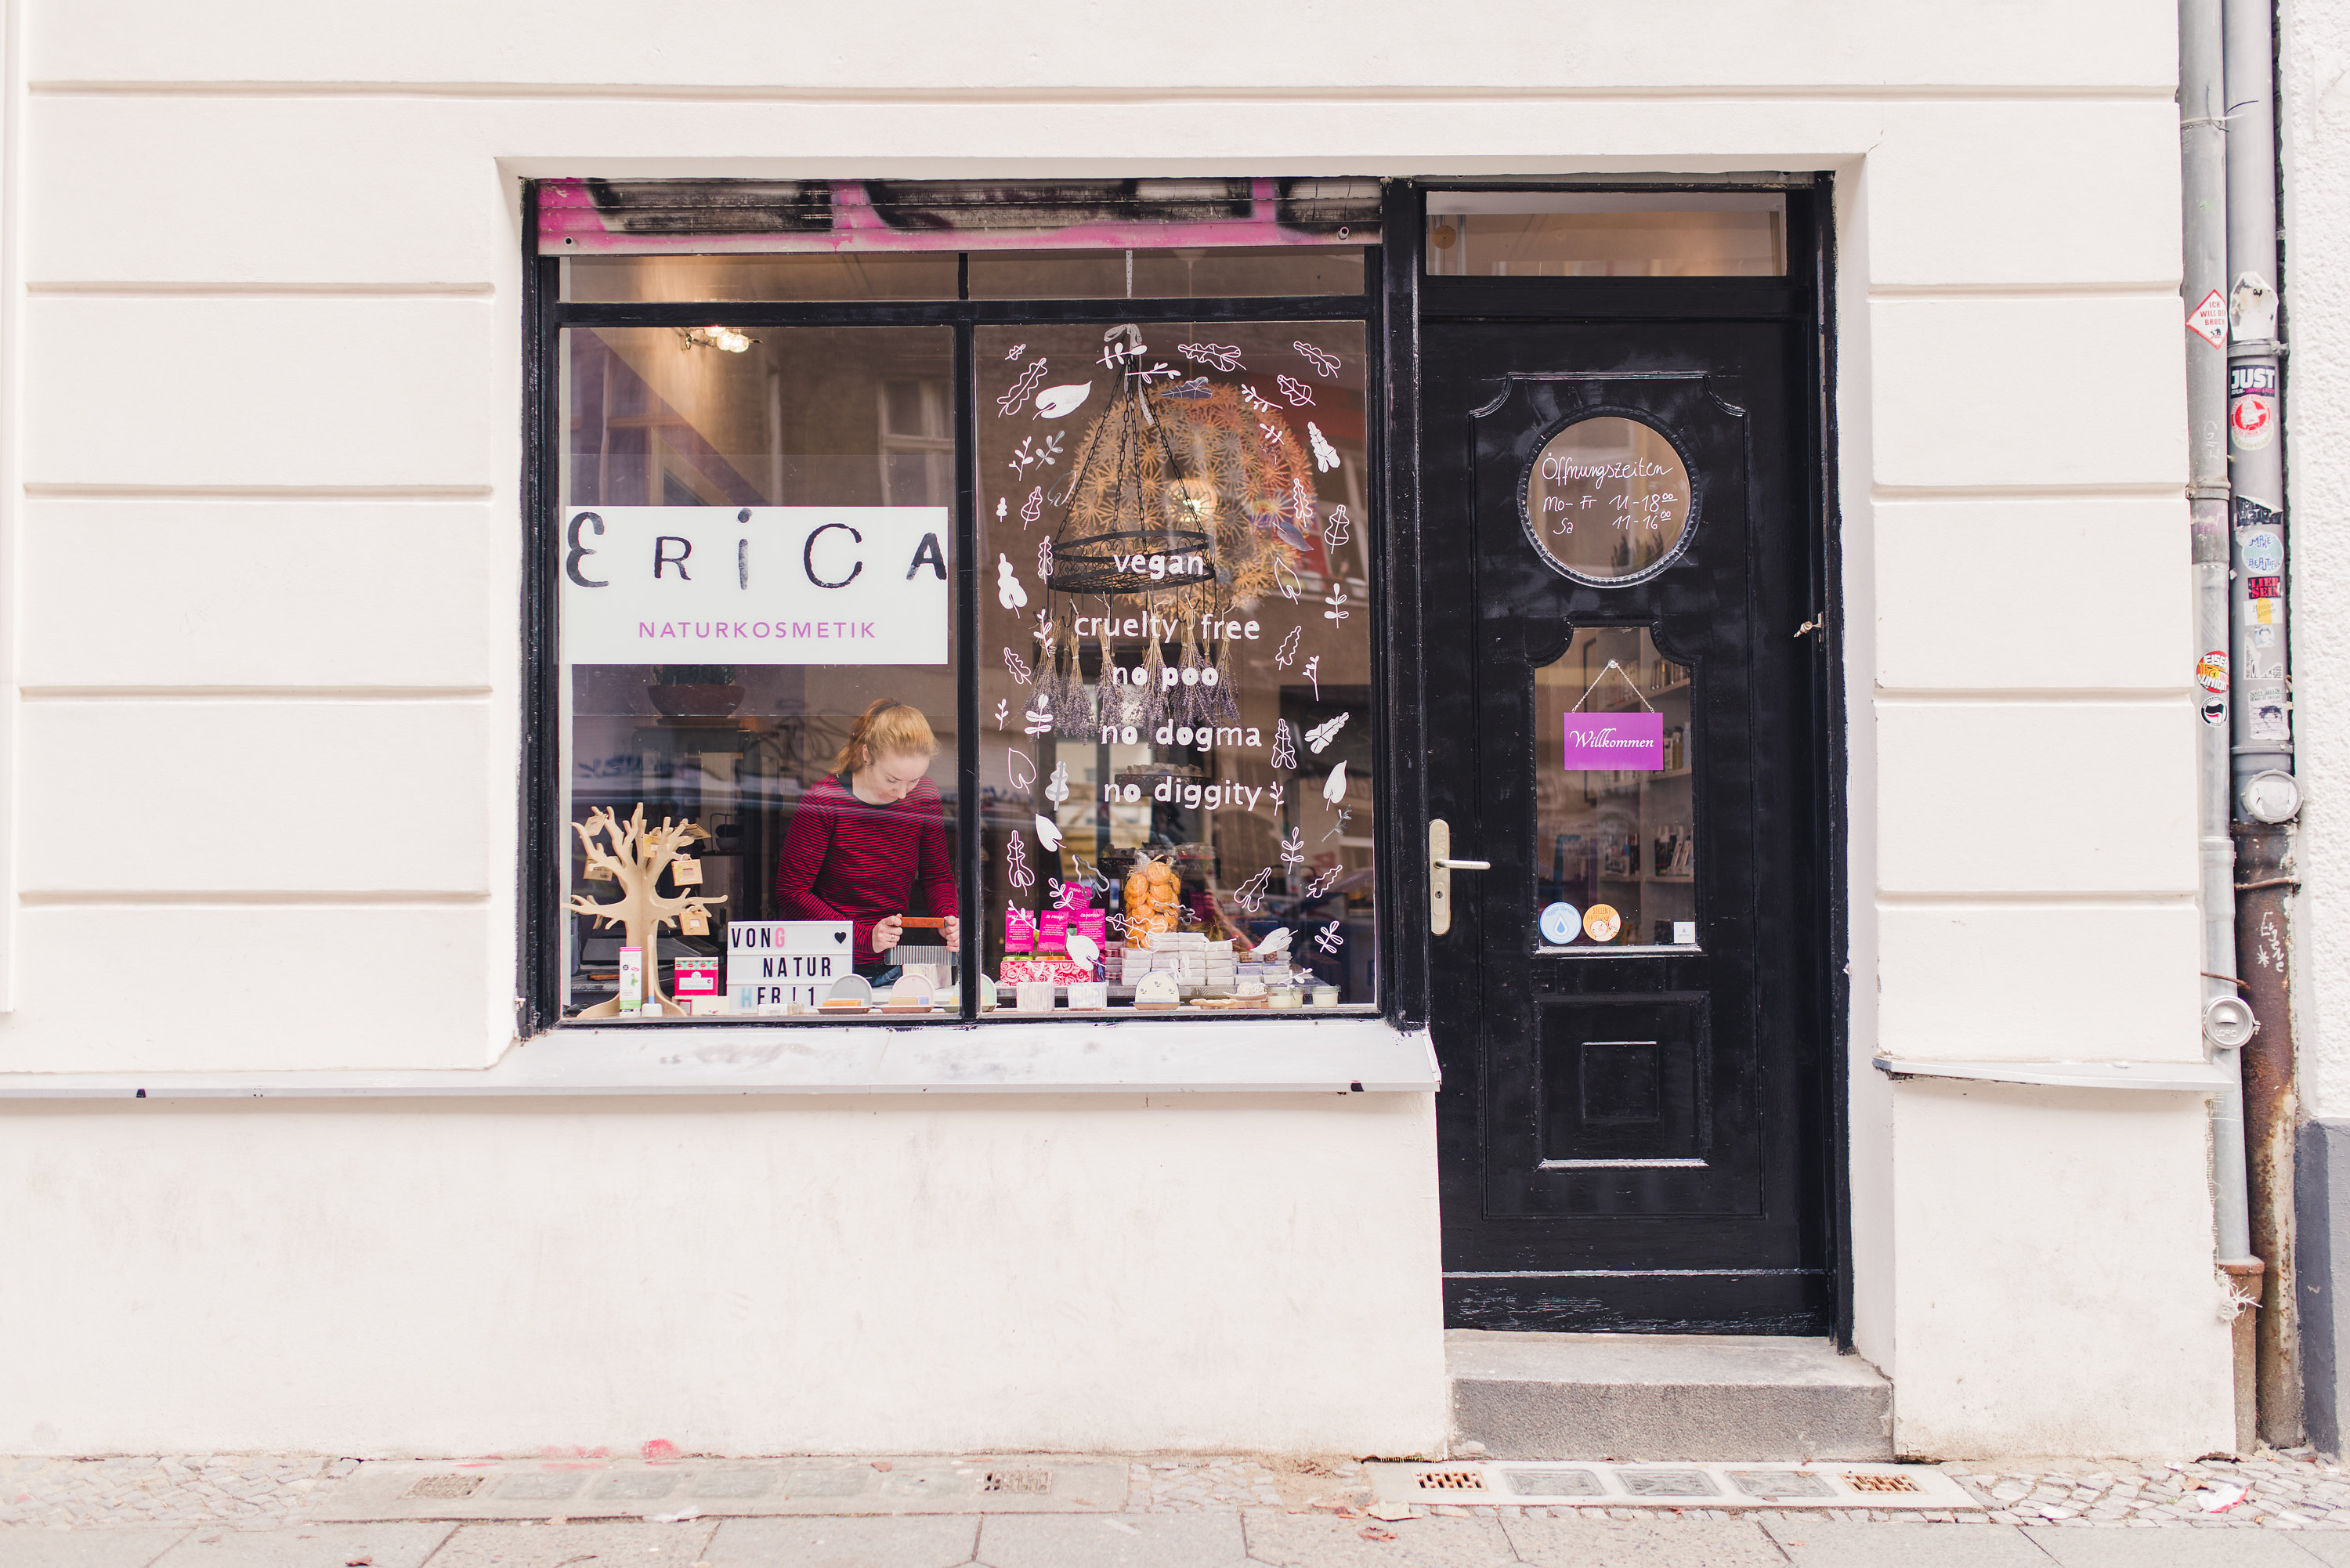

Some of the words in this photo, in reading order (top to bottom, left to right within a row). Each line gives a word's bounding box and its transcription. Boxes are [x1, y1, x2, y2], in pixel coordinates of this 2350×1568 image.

[2200, 309, 2216, 318] WILL
[2231, 367, 2276, 390] JUST
[1542, 452, 1673, 490] Öffnungszeiten
[1579, 495, 1598, 510] Fr
[1553, 518, 1574, 535] Sa
[2250, 535, 2272, 548] MAKE
[1112, 553, 1204, 580] vegan
[638, 622, 876, 638] NATURKOSMETIK
[1074, 610, 1179, 643] cruelty
[1201, 613, 1261, 640] free
[1112, 666, 1148, 686] no
[1162, 665, 1219, 692] poo
[1101, 724, 1138, 746] no
[1155, 718, 1262, 752] dogma
[1569, 728, 1654, 748] Willkommen
[1104, 782, 1141, 803] no
[1154, 775, 1262, 811] diggity
[732, 927, 785, 948] VONG
[763, 956, 831, 977] NATUR
